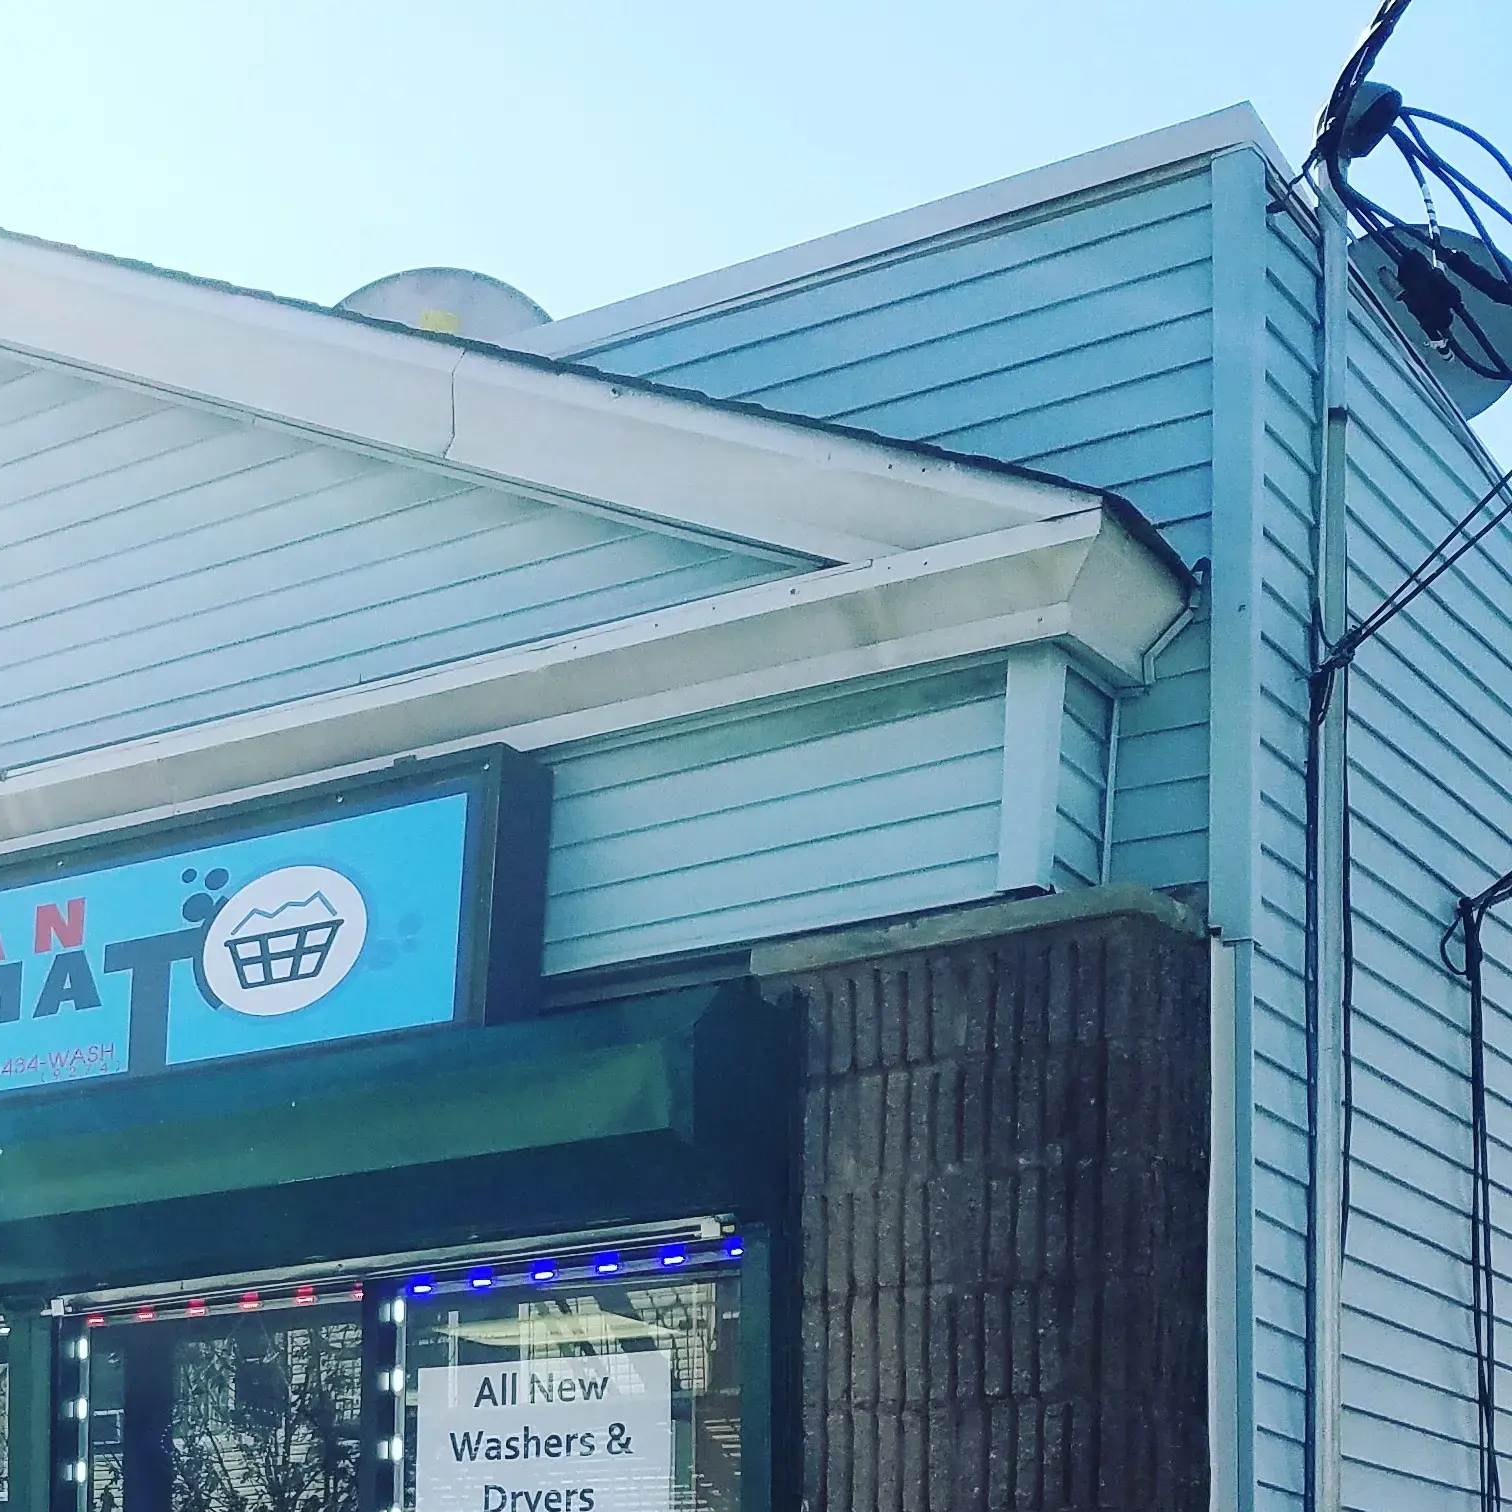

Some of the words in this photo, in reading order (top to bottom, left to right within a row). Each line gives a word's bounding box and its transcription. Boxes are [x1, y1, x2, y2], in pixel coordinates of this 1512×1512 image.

[474, 1372, 517, 1408] All
[530, 1372, 609, 1405] New
[449, 1425, 596, 1462] Washers
[606, 1422, 634, 1456] &
